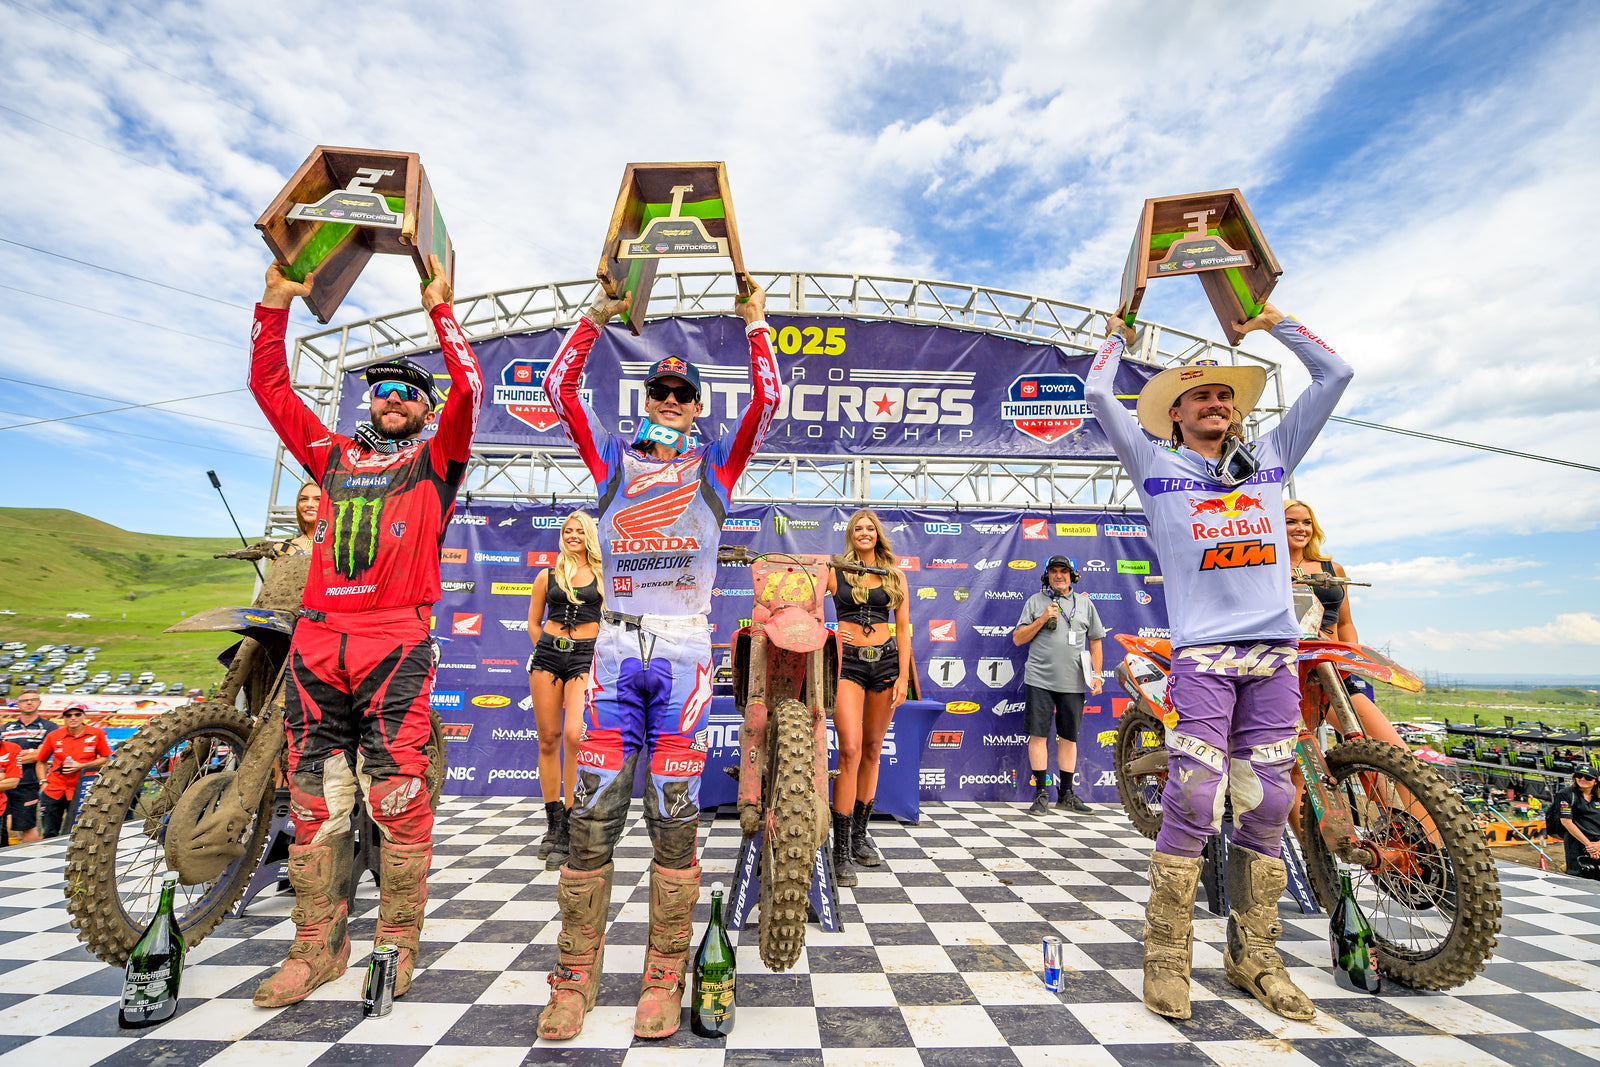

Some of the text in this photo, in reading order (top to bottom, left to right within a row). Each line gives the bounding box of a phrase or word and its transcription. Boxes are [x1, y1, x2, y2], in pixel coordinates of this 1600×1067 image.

[350, 211, 396, 222] MOTOCROSS
[674, 243, 717, 251] MOTOCROSS
[1296, 325, 1315, 341] Red
[769, 326, 847, 356] 2025
[374, 366, 403, 375] YAMAHA
[657, 366, 687, 375] Red Bull
[1040, 384, 1076, 393] TOYOTA
[618, 378, 976, 426] MTCROSS
[515, 406, 556, 414] NATION
[1004, 403, 1094, 417] THUNDER VALLEY
[350, 476, 387, 486] YAMAHA
[925, 523, 961, 534] WPS
[973, 524, 1012, 532] FLY
[1105, 524, 1146, 532] PARTS
[1191, 517, 1273, 541] Red Bull
[612, 537, 701, 554] HONDA
[483, 552, 521, 563] Husqvarna
[1200, 540, 1277, 571] KTM
[616, 556, 695, 573] PROGRESSIVE
[325, 584, 378, 596] PROGRESSIVE
[441, 581, 467, 590] IUMPH
[641, 581, 674, 589] DUNLOP
[761, 571, 819, 603] 18
[985, 589, 1024, 599] NAMURA
[975, 625, 1014, 633] FLY
[1100, 670, 1115, 678] ARM
[430, 694, 461, 704] YAMAHA
[492, 728, 539, 738] NAMUR
[931, 732, 962, 743] ETS
[665, 758, 705, 773] Insta
[446, 766, 476, 781] NBC
[1053, 772, 1080, 786] NC
[960, 771, 1012, 789] peacock
[1505, 825, 1549, 842] KTM
[733, 840, 757, 928] UFOPLAST
